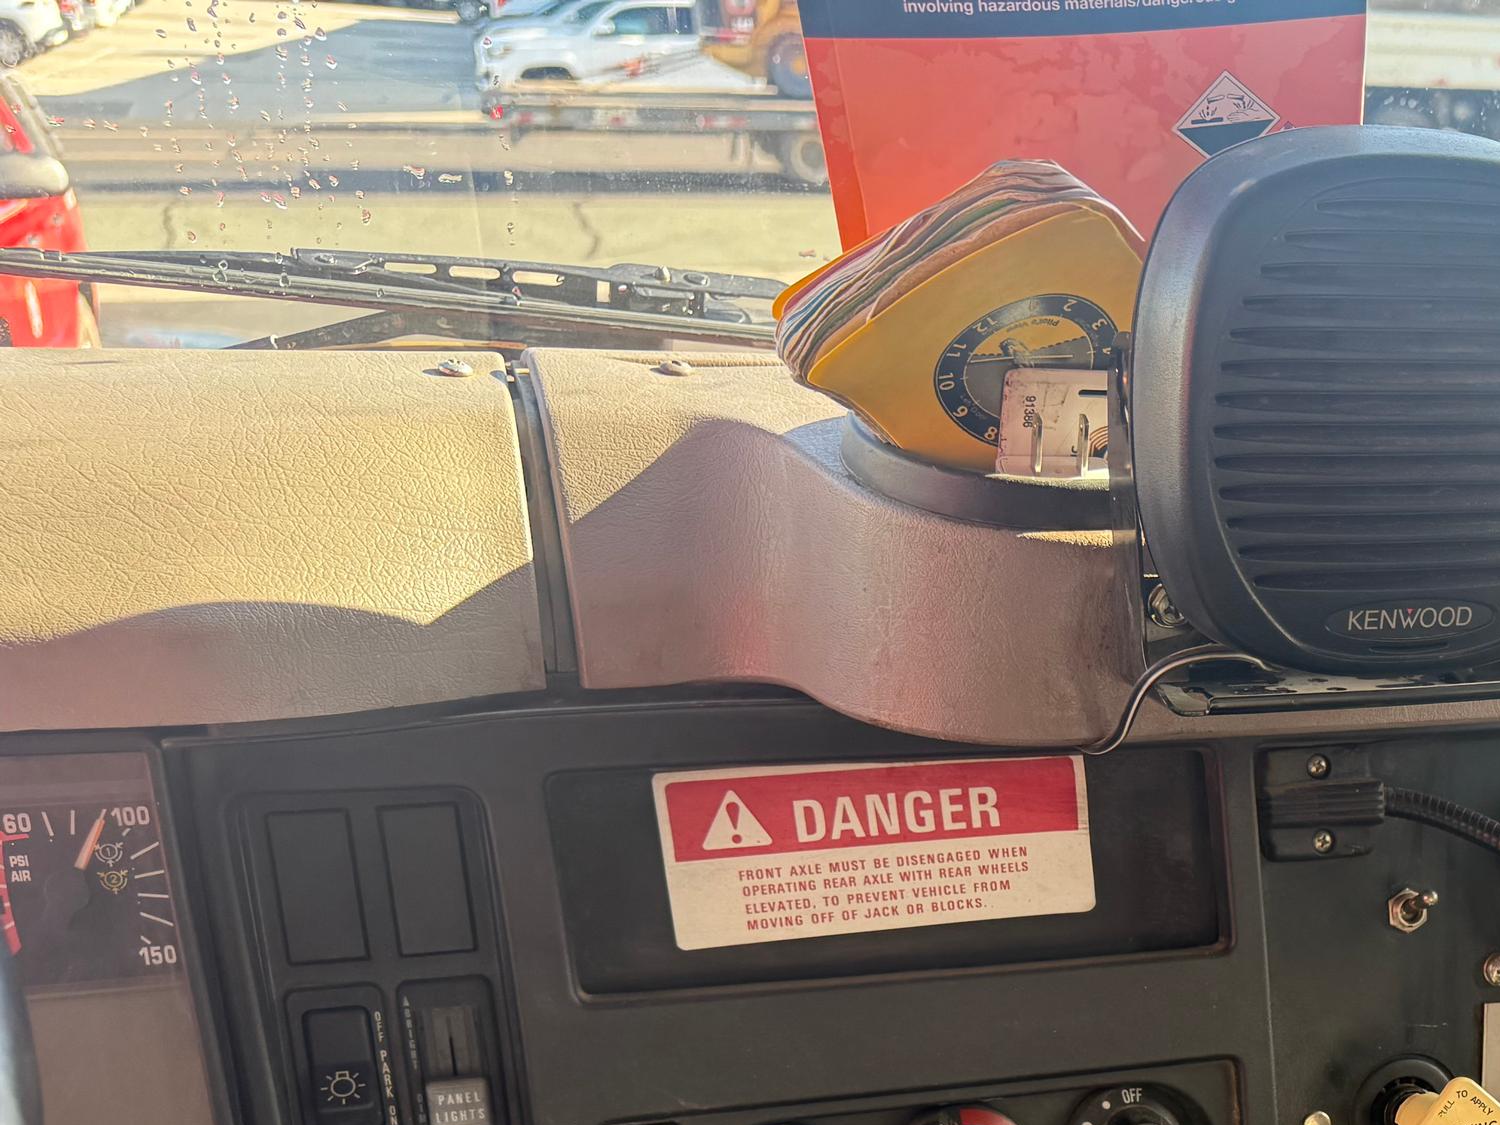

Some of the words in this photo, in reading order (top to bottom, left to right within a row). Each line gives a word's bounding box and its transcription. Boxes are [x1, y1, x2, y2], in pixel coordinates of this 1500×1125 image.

[904, 0, 974, 15] involving
[978, 0, 1060, 12] hazardous
[1348, 606, 1472, 631] KENWOOD
[3, 813, 32, 834] 60
[110, 805, 150, 827] 100
[792, 786, 1001, 843] DANGER
[9, 855, 30, 867] PSI
[738, 867, 783, 882] FRONT
[789, 863, 822, 877] AXLE
[829, 859, 866, 873] MUST
[874, 857, 890, 870] BE
[896, 849, 981, 867] DISENGAGED
[988, 846, 1028, 860] WHEN
[11, 870, 32, 882] AIR
[742, 879, 817, 897] OPERATING
[823, 876, 857, 890] REAR
[863, 873, 894, 886] AXLE
[899, 869, 933, 882] WITH
[939, 866, 972, 879] REAR
[978, 861, 1029, 876] WHEELS
[745, 899, 817, 915] ELEVATED,
[822, 896, 840, 907] TO
[847, 889, 905, 905] PREVENT
[912, 883, 967, 899] VEHICLE
[973, 880, 1011, 893] FROM
[747, 915, 804, 931] MOVING
[811, 912, 835, 925] OFF
[842, 910, 859, 921] OF
[864, 905, 900, 920] JACK
[906, 903, 924, 915] OR
[931, 898, 988, 913] BLOCKS.
[138, 945, 177, 965] 150
[373, 1011, 384, 1042] OFF
[380, 1050, 394, 1098] PARK
[388, 1105, 398, 1125] ON
[438, 1092, 482, 1106] PANEL
[1121, 1088, 1142, 1103] OFF
[1456, 1090, 1468, 1099] TO
[1470, 1096, 1494, 1116] APPLY
[435, 1108, 486, 1124] LIGHTS
